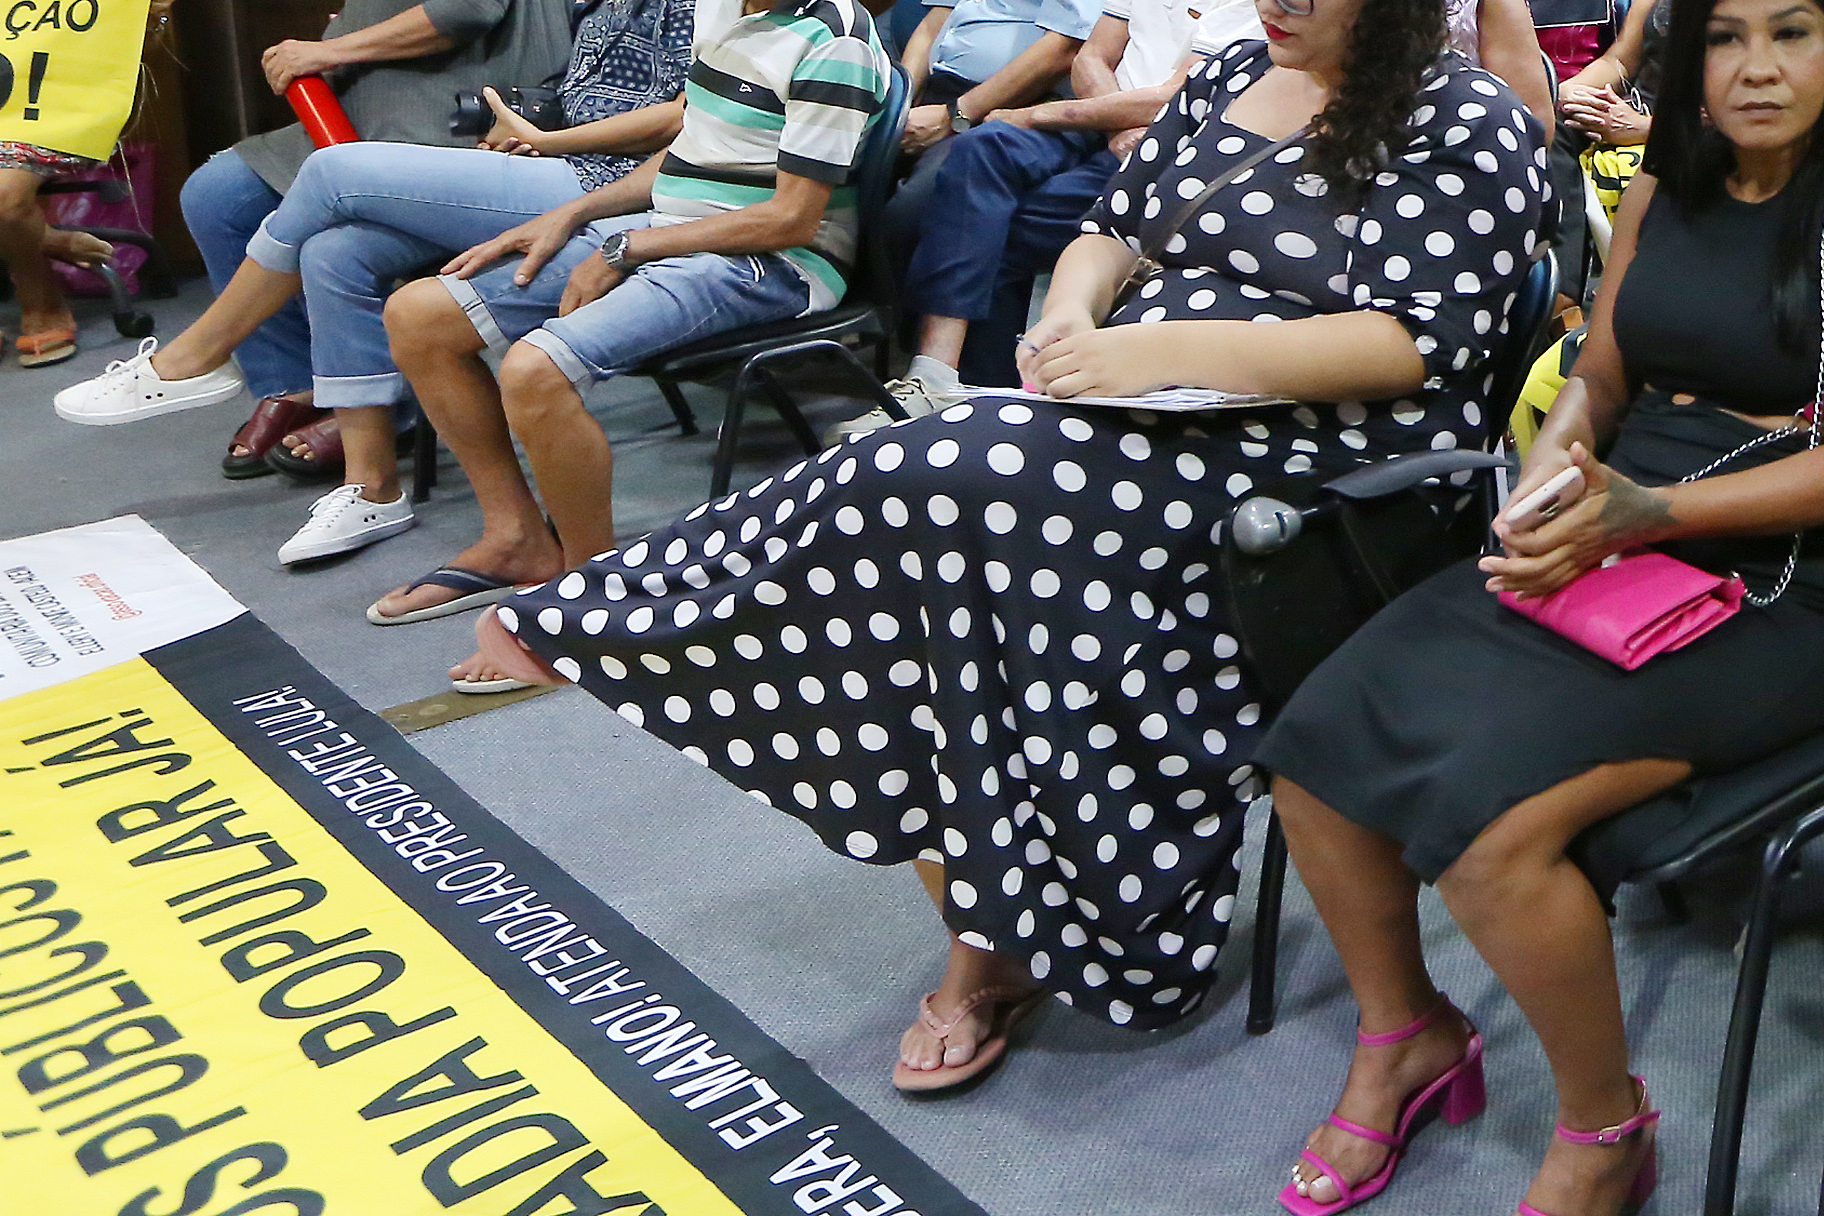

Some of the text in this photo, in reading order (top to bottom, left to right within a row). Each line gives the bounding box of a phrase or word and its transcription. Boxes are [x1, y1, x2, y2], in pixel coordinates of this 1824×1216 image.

[5, 708, 193, 789] JÁ!
[232, 685, 339, 747] LULA!
[286, 732, 486, 874] PRESIDENTE
[96, 778, 459, 1069] POPULAR
[435, 860, 530, 905] AO
[477, 891, 648, 1005] ATENDA
[590, 993, 805, 1151] ELMANO!
